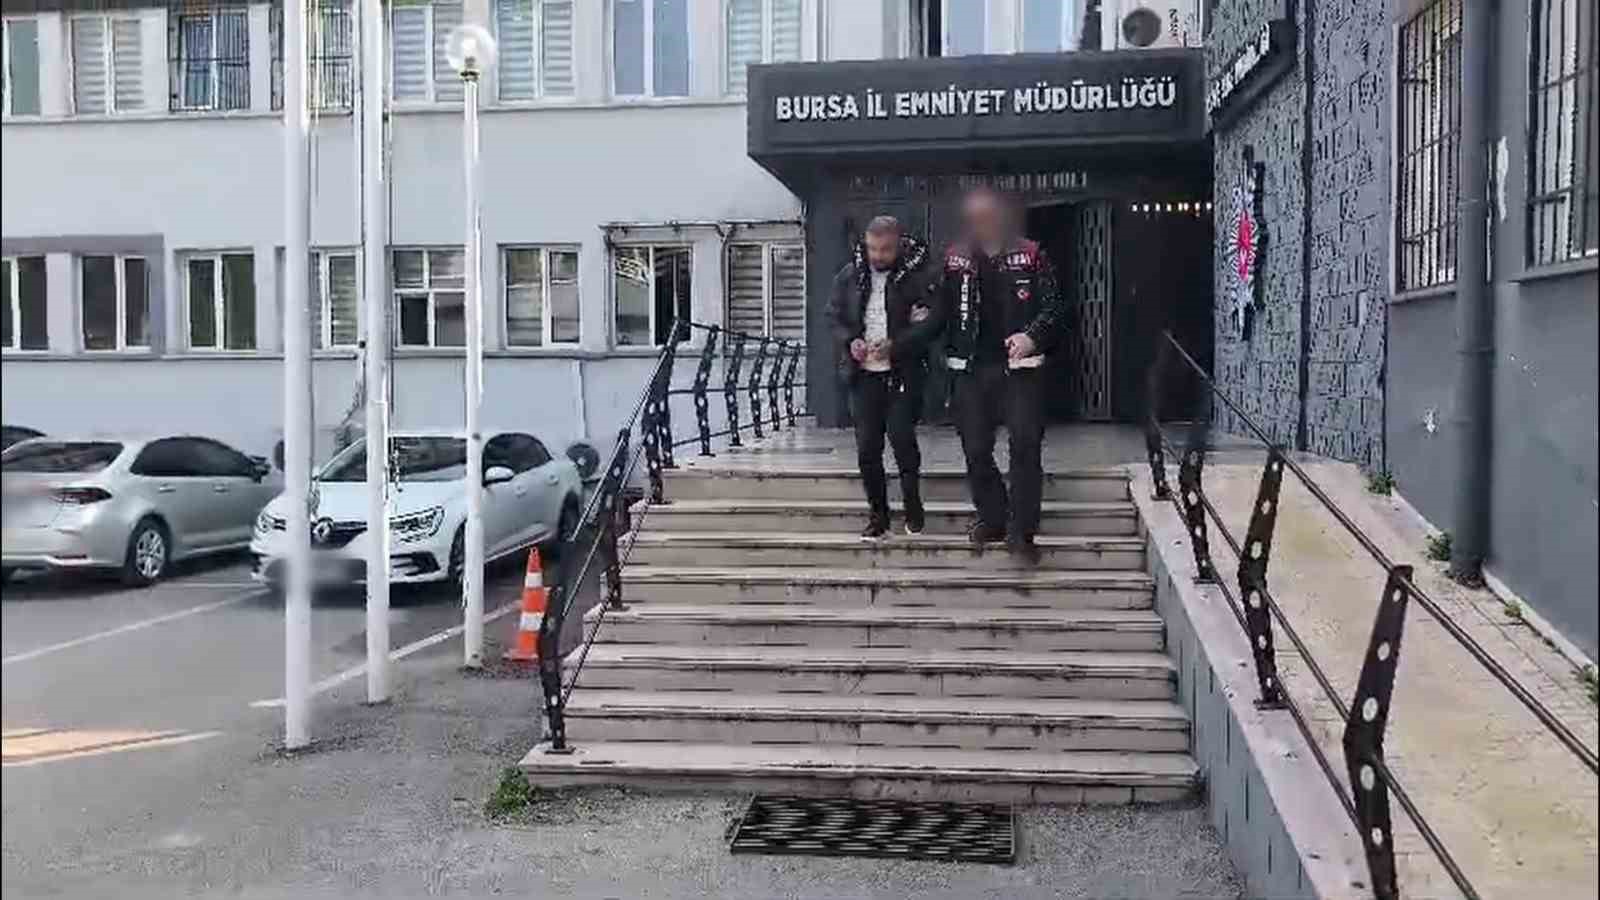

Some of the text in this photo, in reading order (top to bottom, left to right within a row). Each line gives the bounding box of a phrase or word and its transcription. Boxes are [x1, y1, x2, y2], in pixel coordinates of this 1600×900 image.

[776, 76, 1176, 120] BURSA İL EMNİYET MÜDÜRLÜĞÜ
